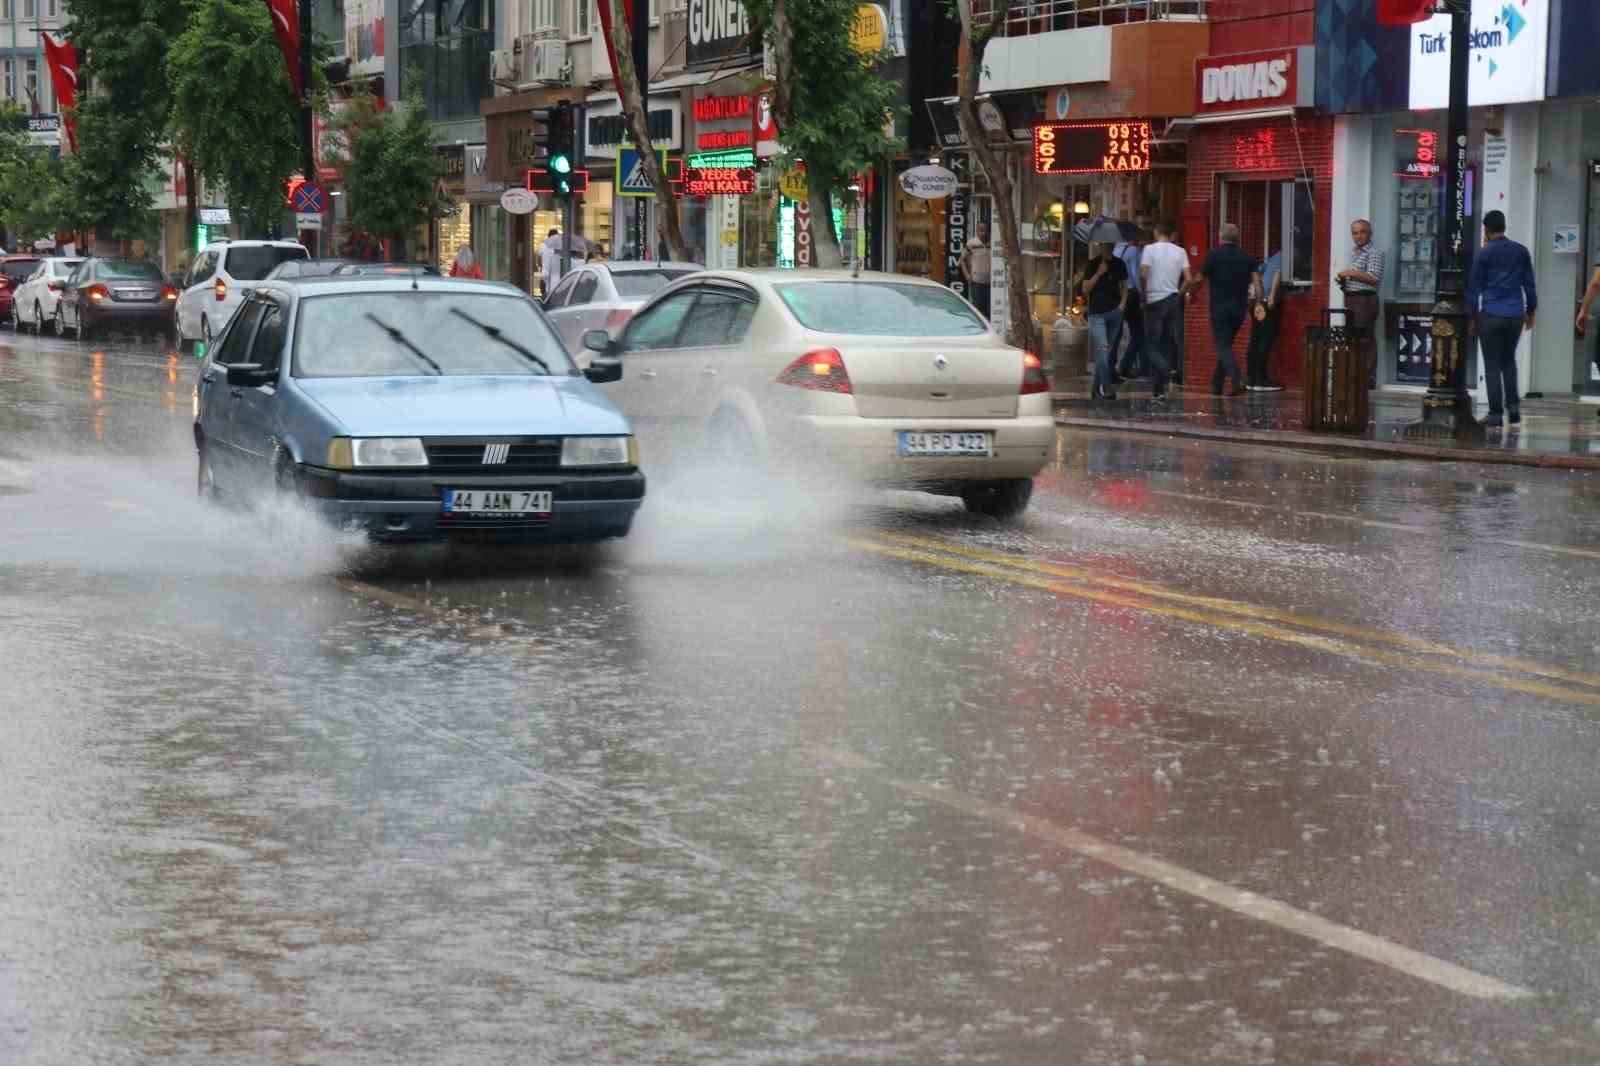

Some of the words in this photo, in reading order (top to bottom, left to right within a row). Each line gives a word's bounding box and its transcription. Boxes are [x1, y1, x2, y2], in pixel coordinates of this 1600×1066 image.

[700, 169, 738, 180] YEDEK
[718, 181, 750, 191] KART
[454, 492, 473, 510] 44
[482, 492, 513, 510] AAN
[520, 492, 550, 510] 741
